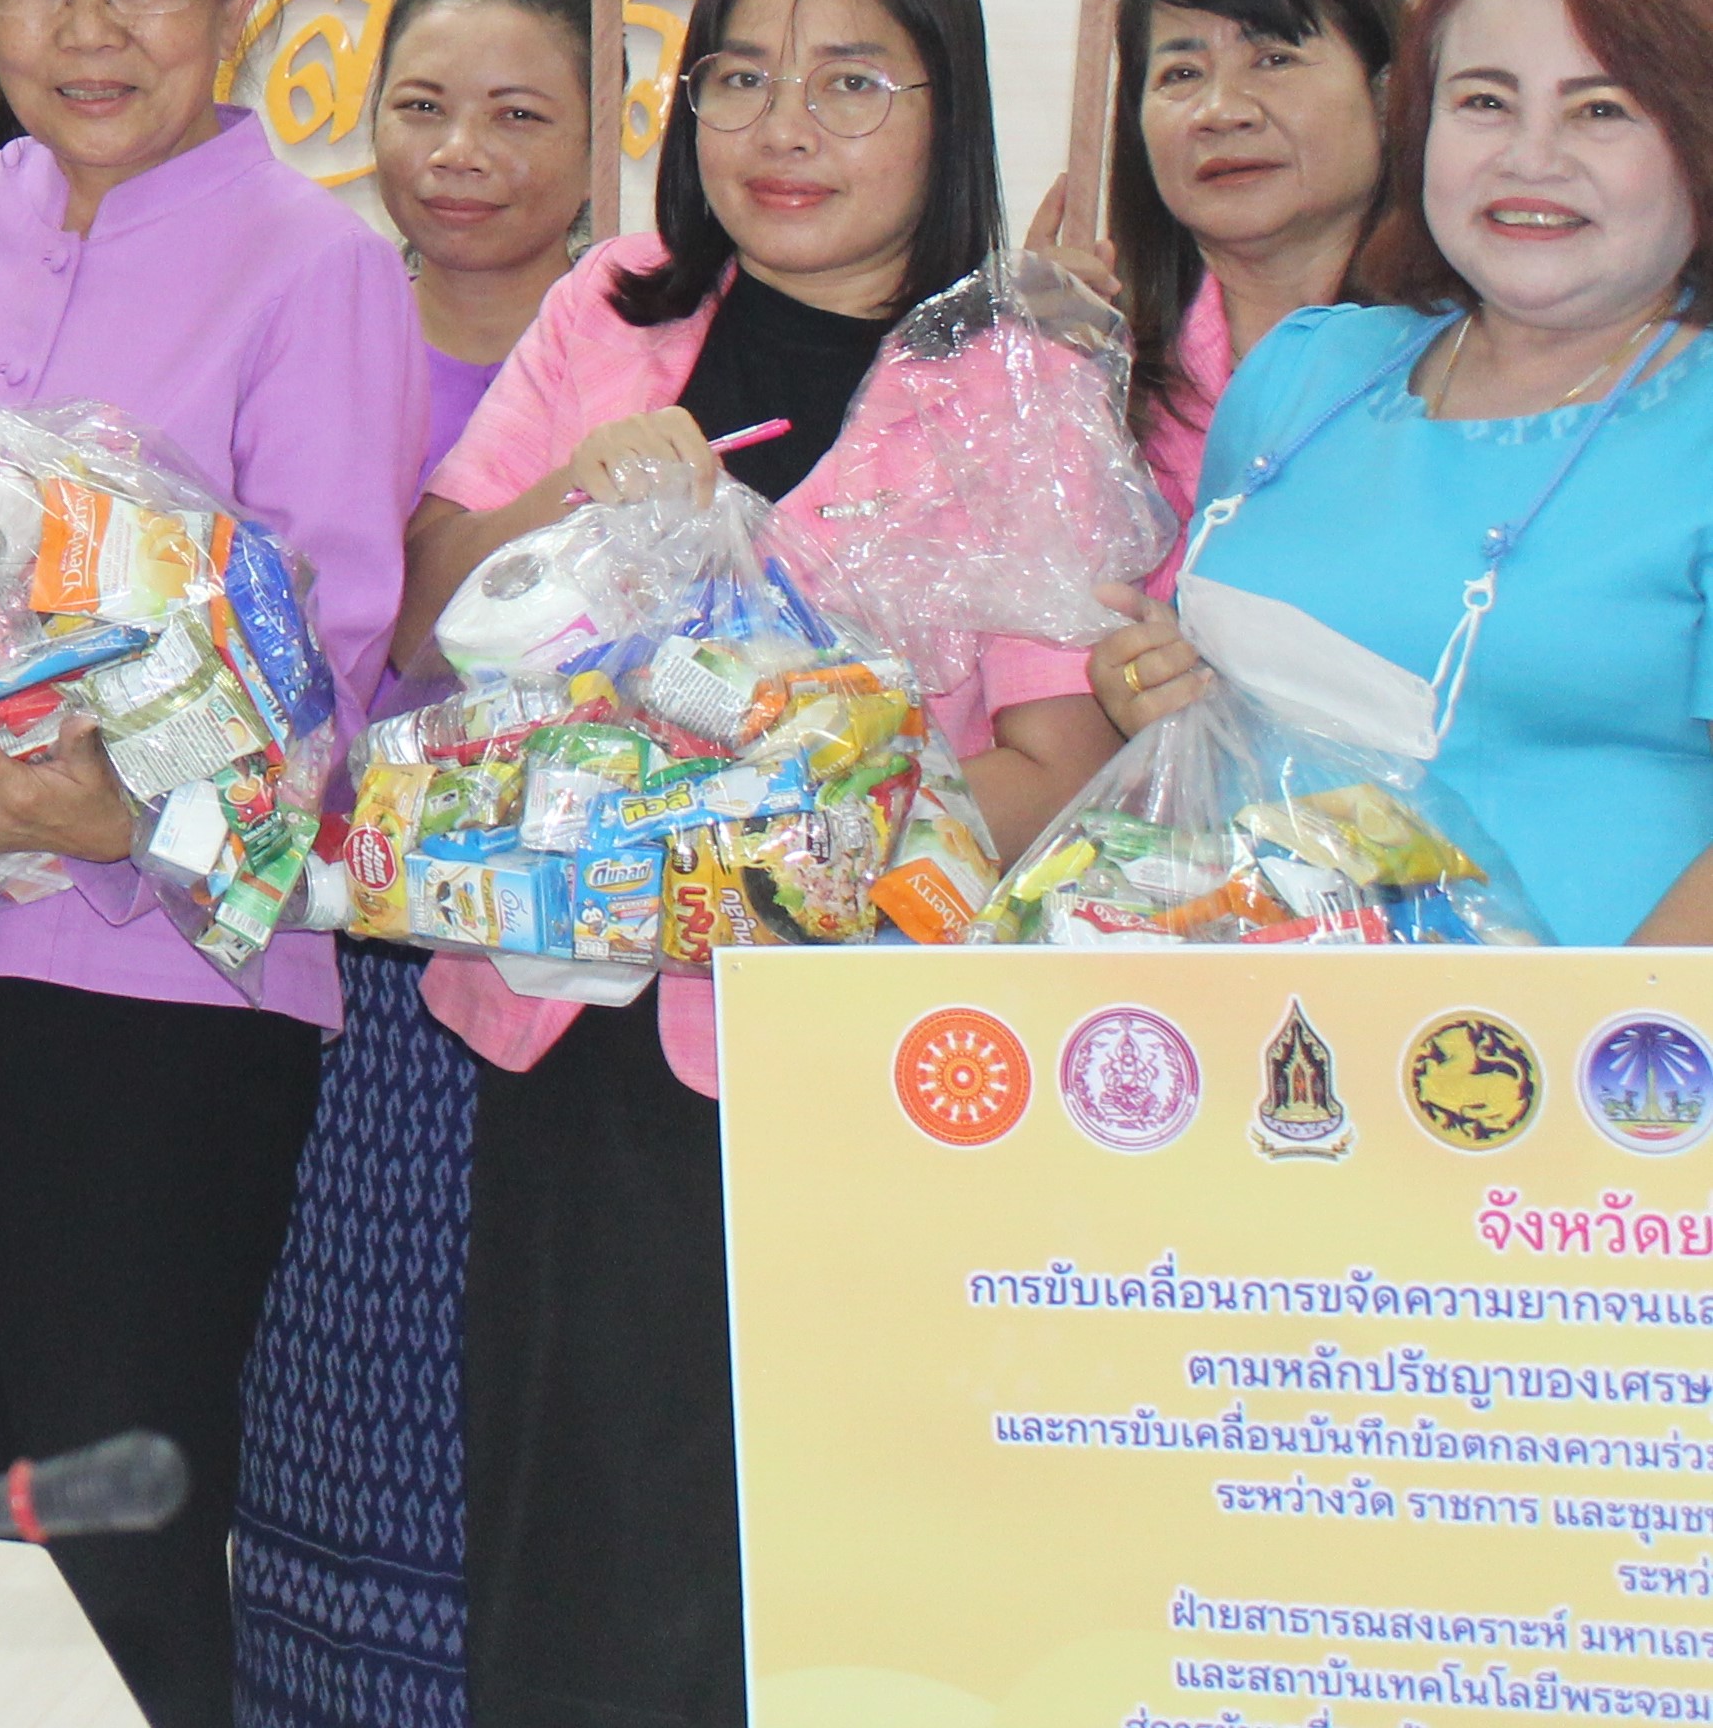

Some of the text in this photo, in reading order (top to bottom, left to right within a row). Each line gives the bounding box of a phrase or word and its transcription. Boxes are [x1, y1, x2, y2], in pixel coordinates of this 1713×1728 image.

[1478, 1189, 1713, 1256] จังหวัดย
[1217, 1475, 1395, 1519] ระหว่างวัด
[1408, 1488, 1539, 1525] ราชการ
[1171, 1589, 1568, 1650] ฝ่ายสาธารณสงเคราะห์
[1174, 1657, 1711, 1723] และสถาบันเทคโนโลยีพระจอม
